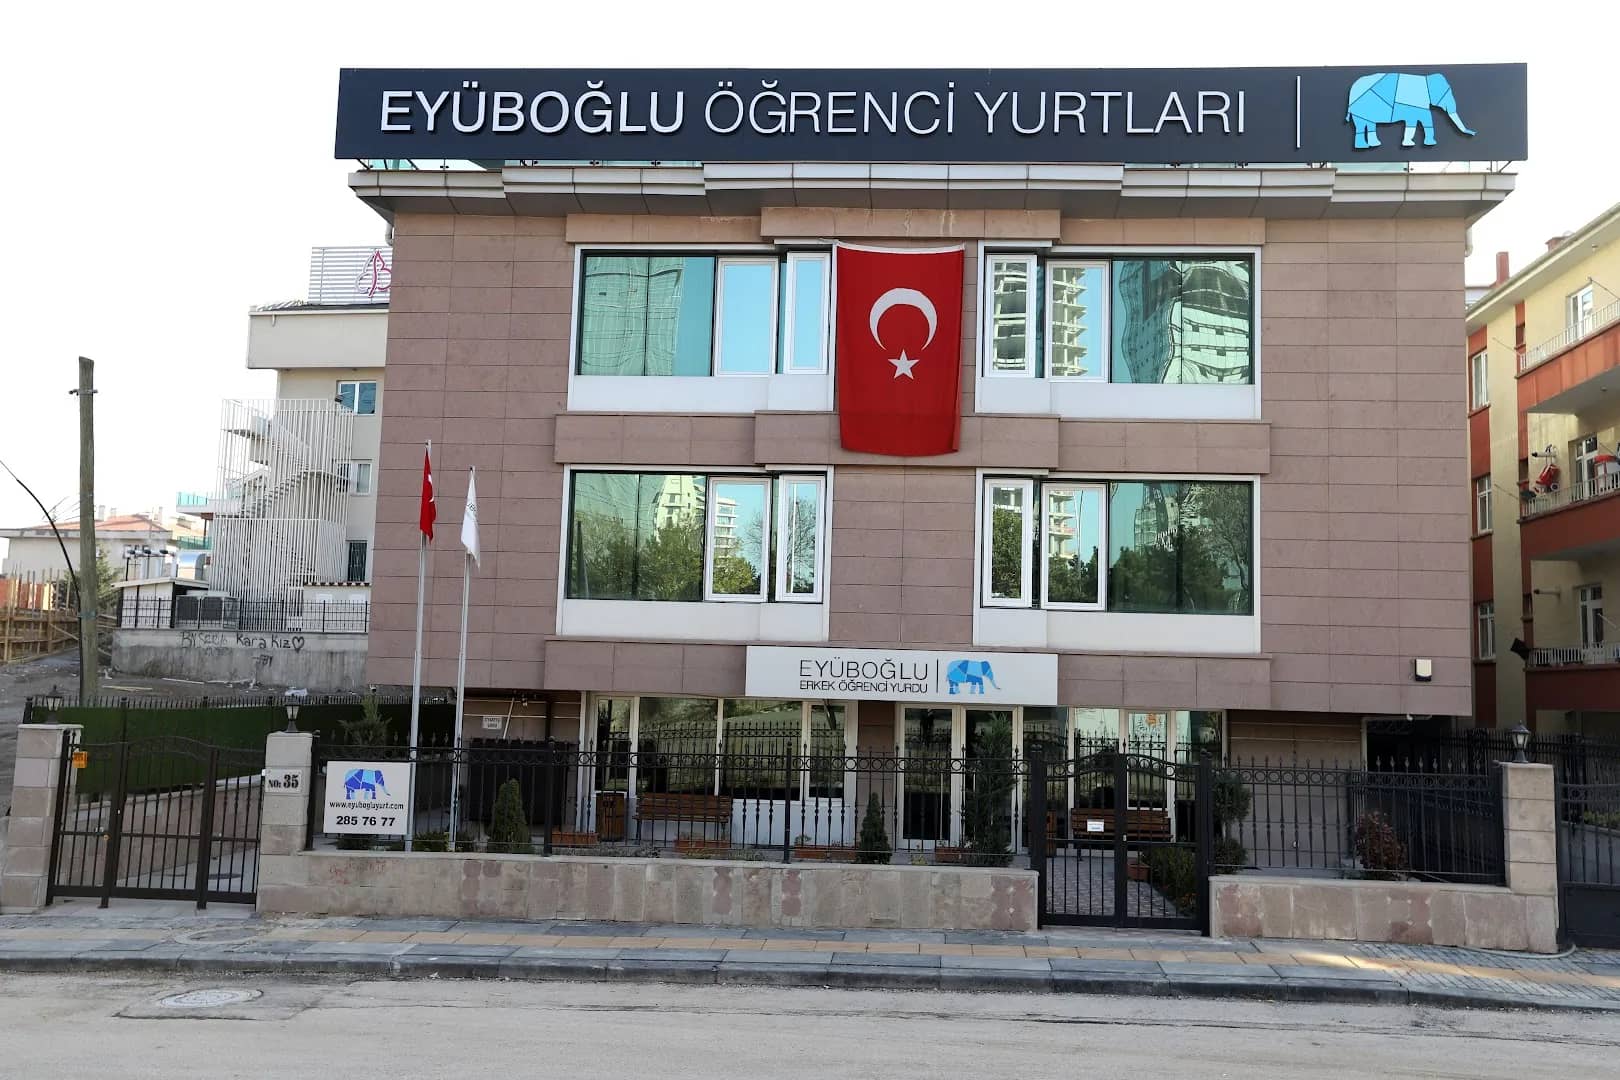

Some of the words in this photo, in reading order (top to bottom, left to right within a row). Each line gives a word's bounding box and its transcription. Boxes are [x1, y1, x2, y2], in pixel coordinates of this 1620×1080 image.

[380, 80, 685, 135] EYÜBOĞLU
[704, 79, 955, 135] ÖĞRENCİ
[974, 90, 1246, 135] YURTLARI
[799, 656, 929, 681] EYÜBOĞLU
[799, 680, 836, 691] ERKEK
[838, 679, 888, 693] ÖĞRENCİ
[890, 682, 928, 694] YURDU
[283, 774, 299, 788] 35
[336, 815, 358, 826] 285
[361, 816, 377, 826] 76
[380, 817, 396, 827] 77
